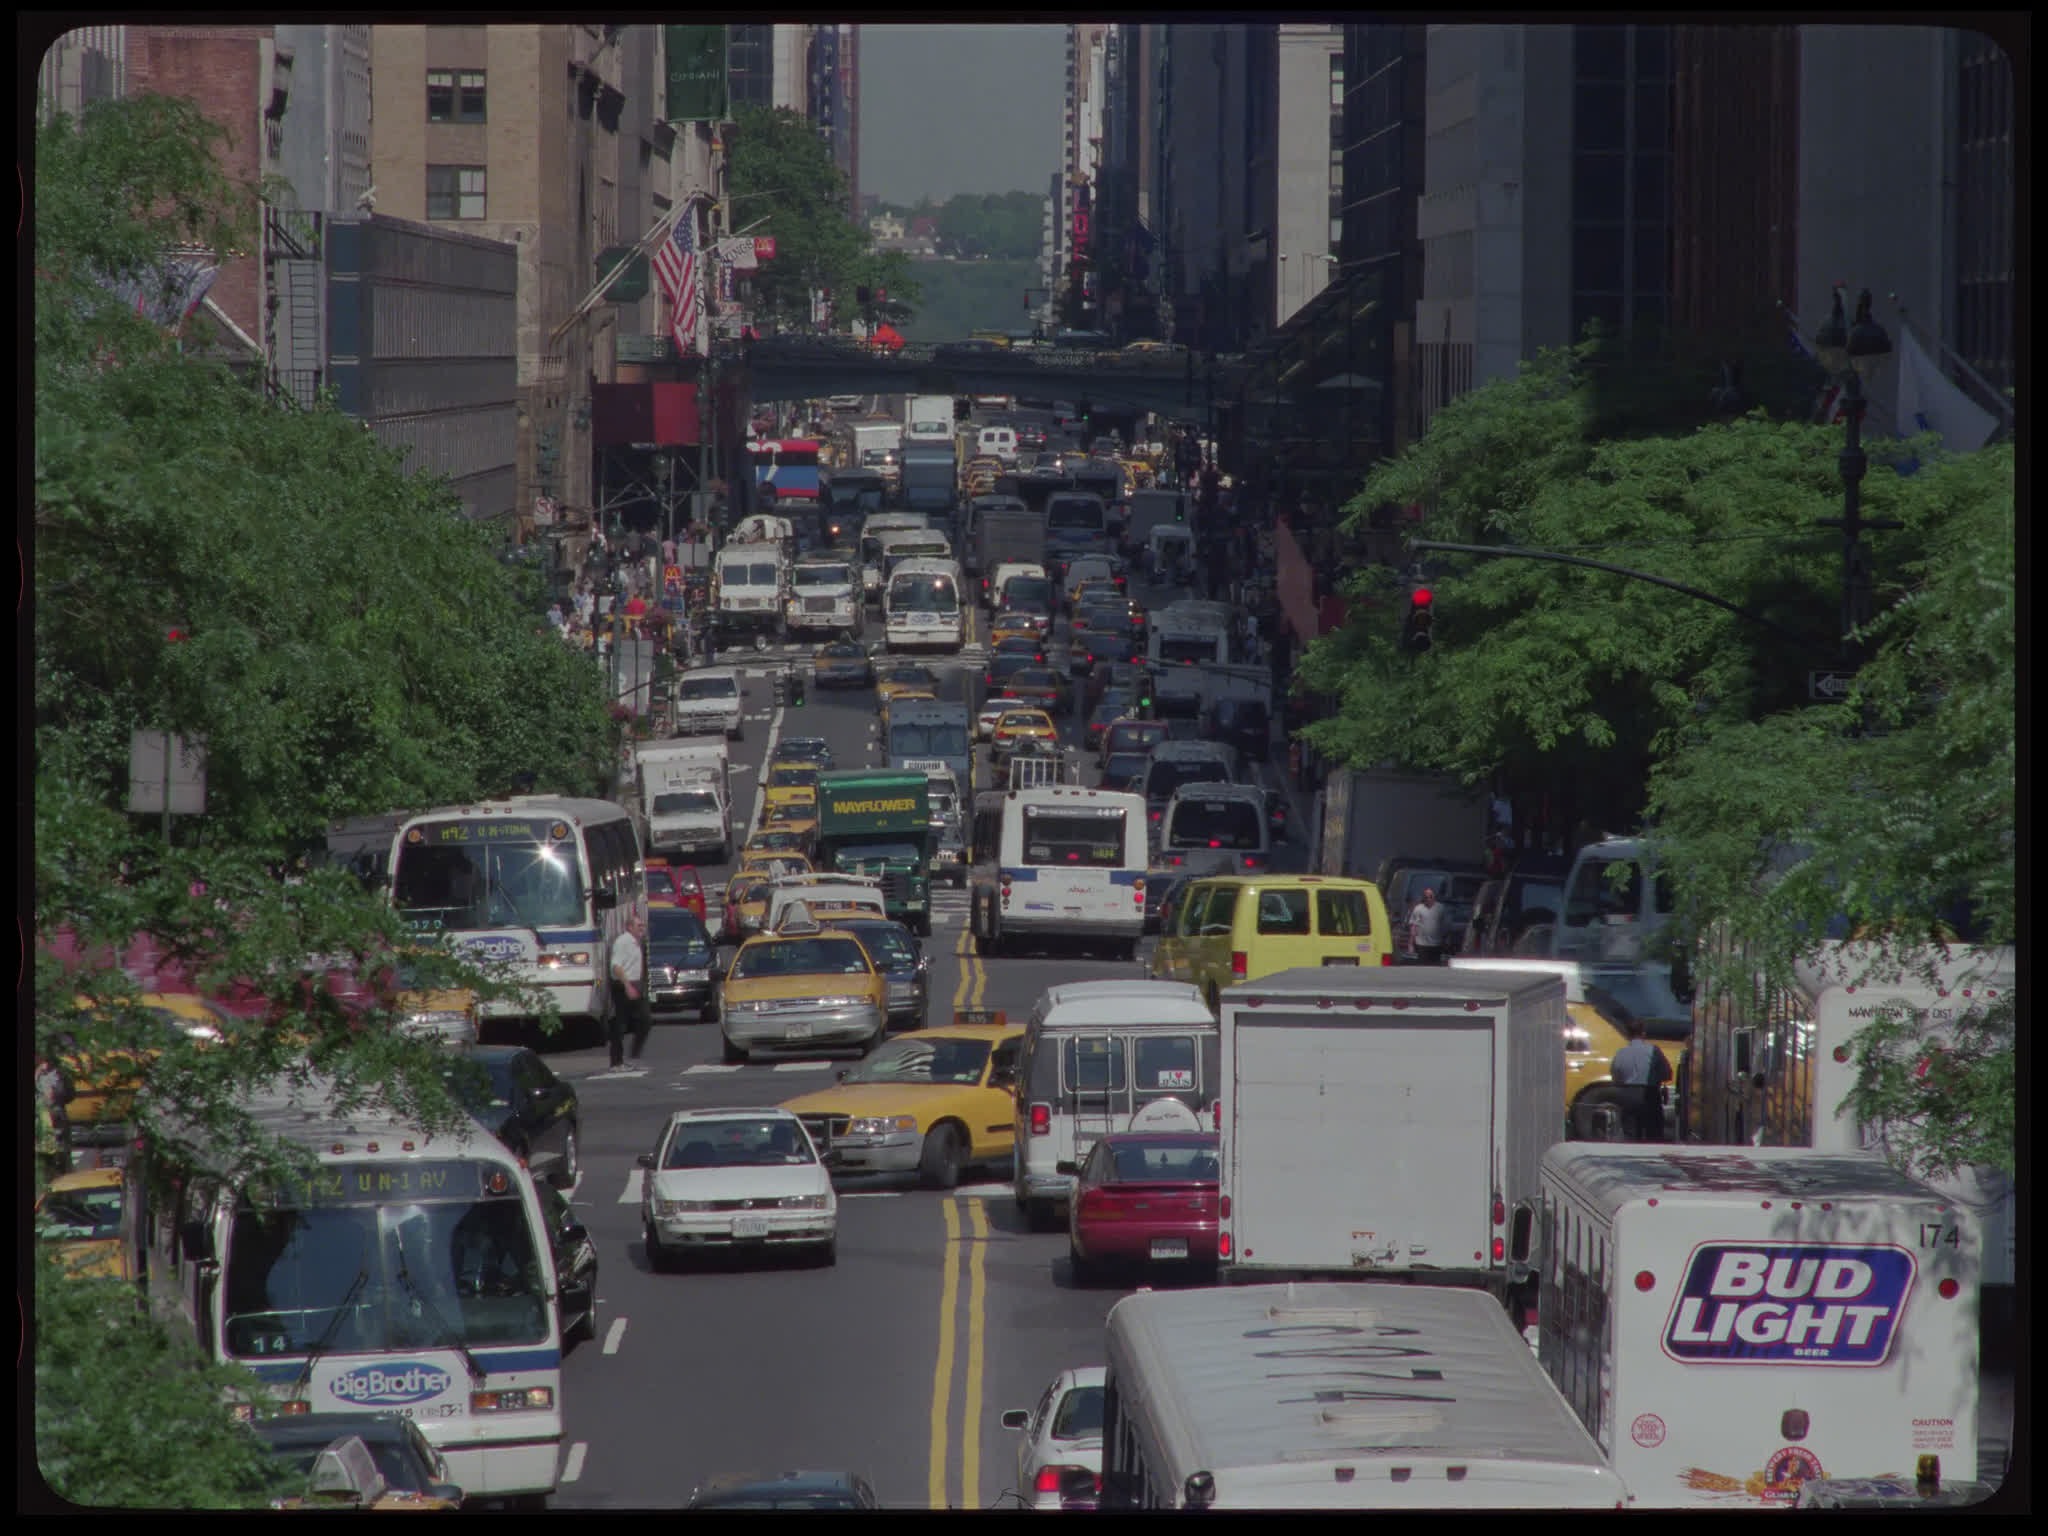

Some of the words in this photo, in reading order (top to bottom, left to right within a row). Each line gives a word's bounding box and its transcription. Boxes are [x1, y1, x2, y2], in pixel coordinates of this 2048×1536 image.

[833, 798, 915, 814] MAYFLOWER
[1919, 1223, 1960, 1249] 174
[1709, 1251, 1874, 1299] BUD
[1671, 1297, 1890, 1346] LIGHT
[1793, 1347, 1830, 1358] BEER
[1911, 1418, 1953, 1426] CAUTION
